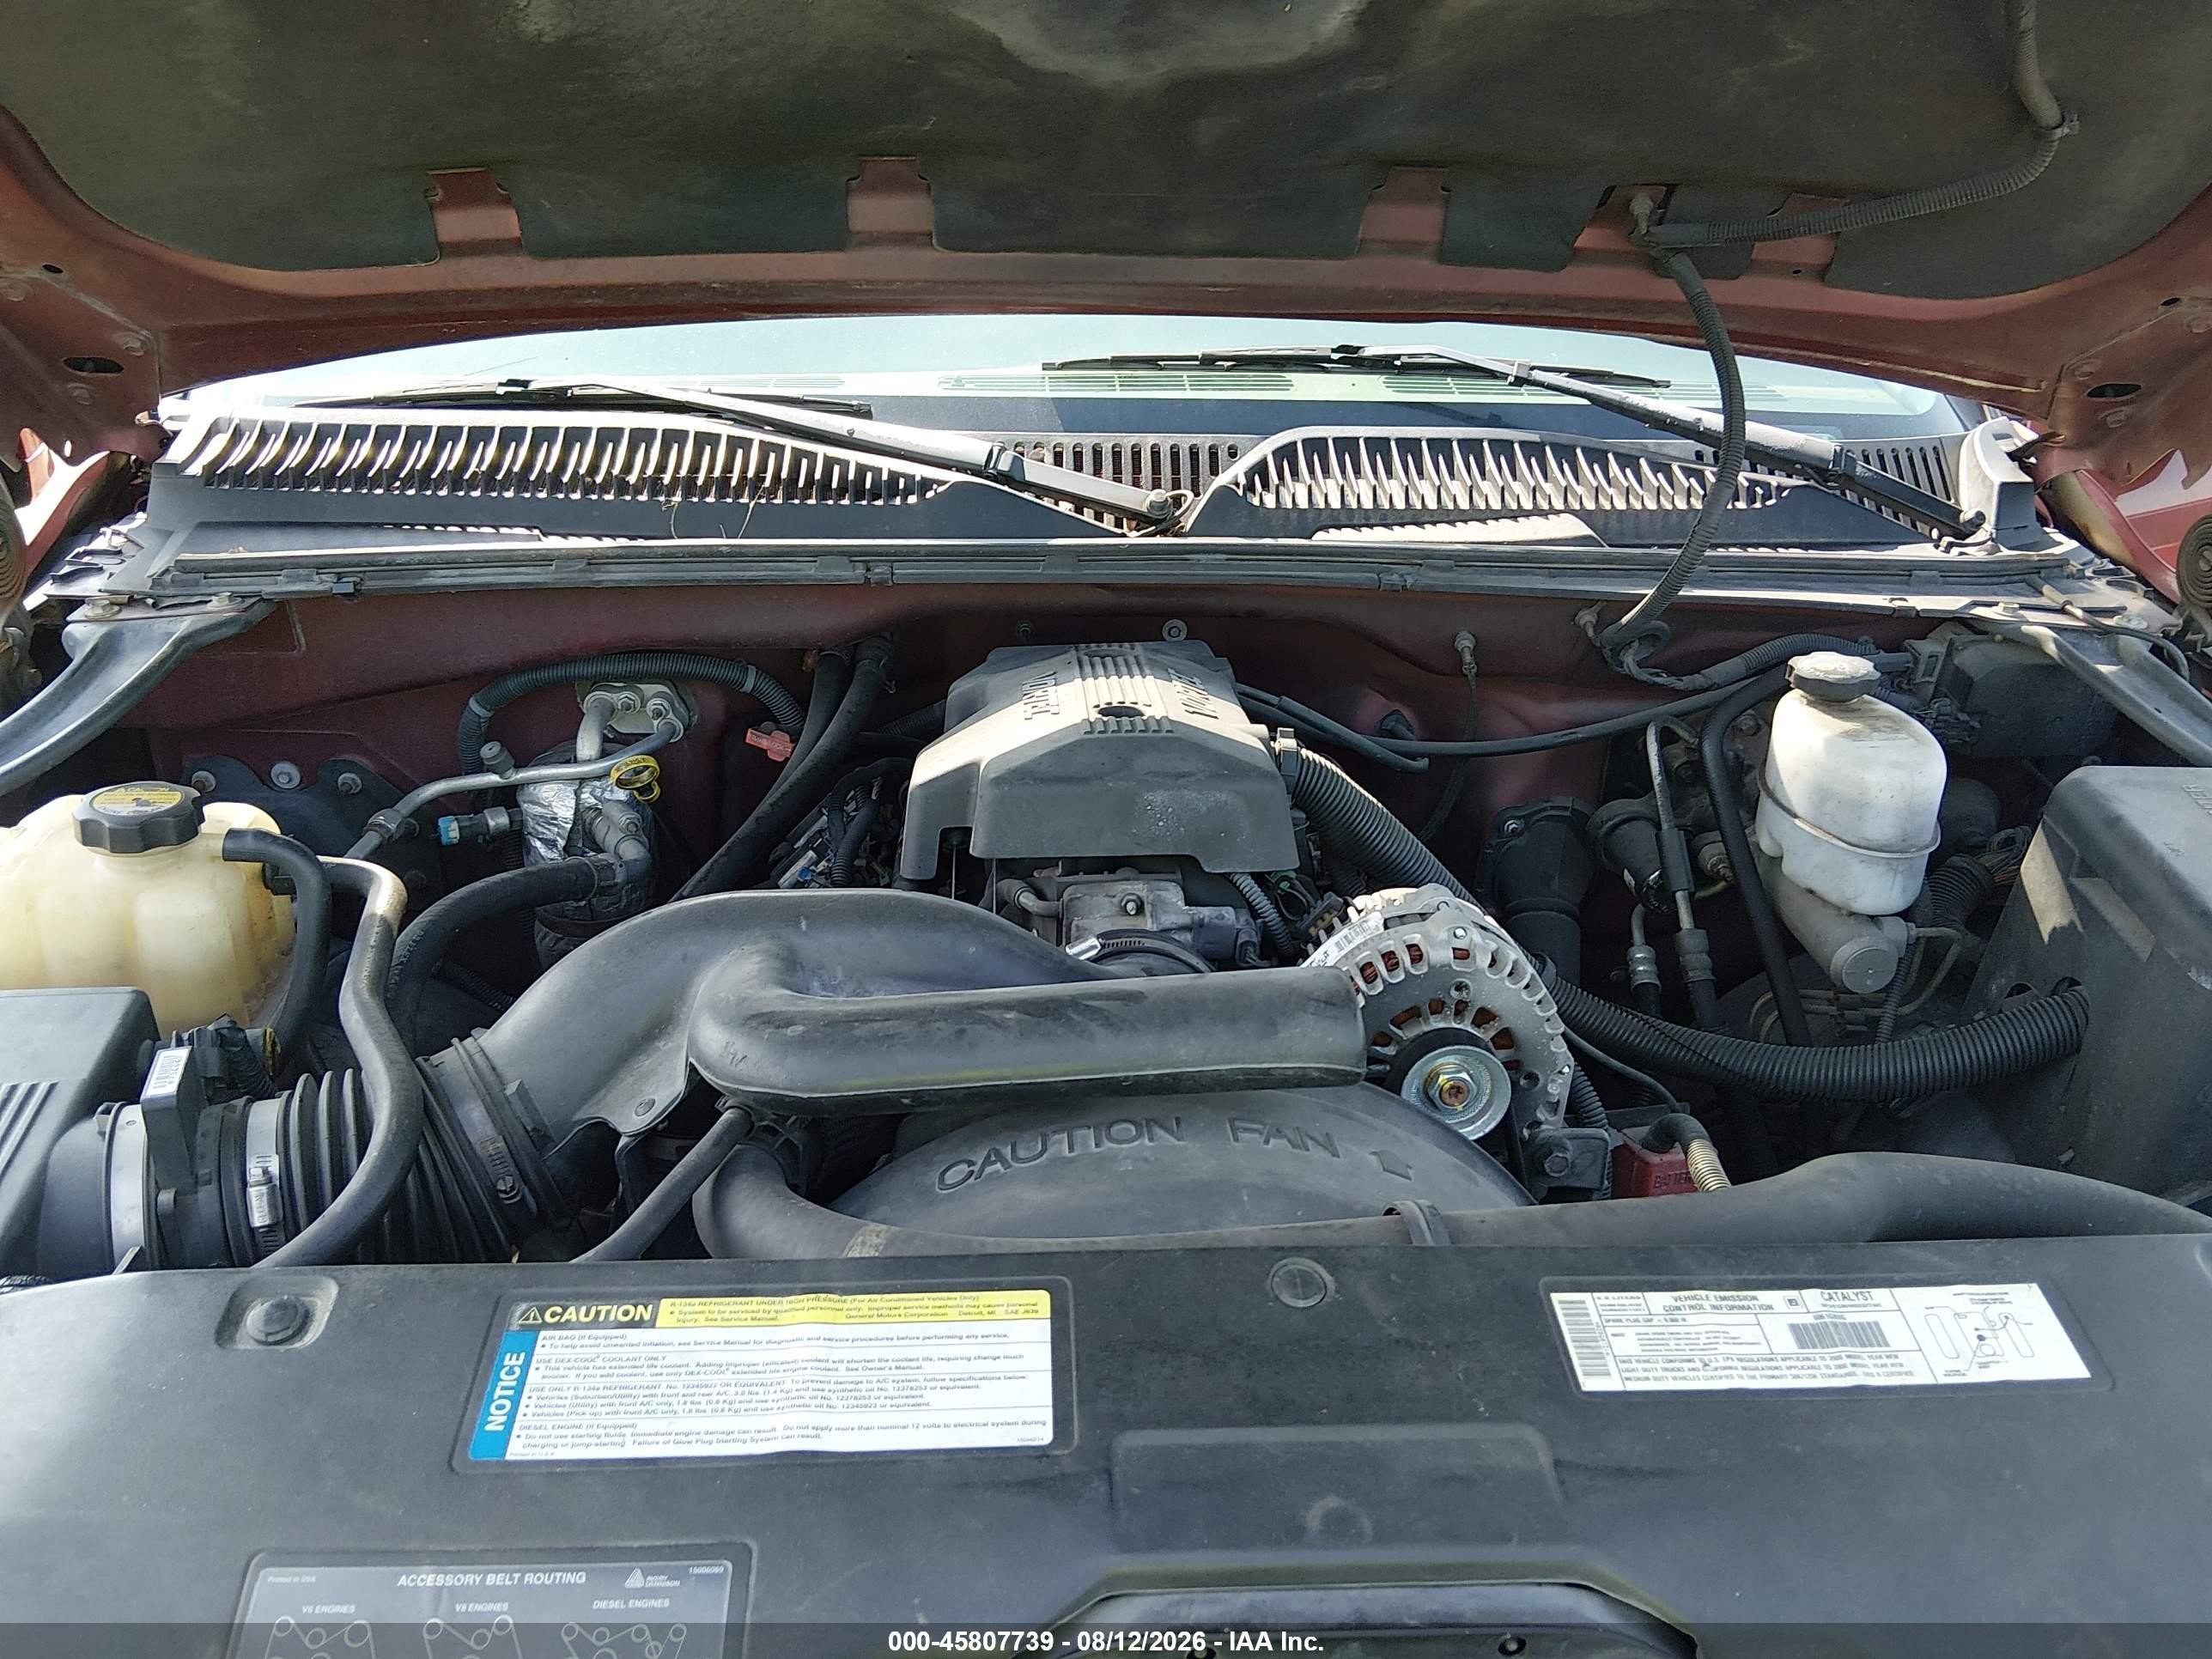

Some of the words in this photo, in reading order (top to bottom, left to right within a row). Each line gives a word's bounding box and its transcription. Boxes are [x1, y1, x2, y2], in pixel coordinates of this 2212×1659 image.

[936, 1117, 1184, 1192] CAUTION
[1226, 1119, 1340, 1159] FAN
[1654, 1171, 1693, 1189] BATTER
[1820, 1291, 1876, 1302] CATALYST
[544, 1304, 653, 1323] CAUTION
[484, 1352, 526, 1431] NOTICE
[397, 1574, 483, 1587] ACCESSORY
[486, 1573, 520, 1585] BELT
[524, 1571, 586, 1585] ROUTING
[314, 1604, 356, 1613] ENGINES
[455, 1603, 465, 1612] V8
[468, 1602, 508, 1612] ENGINES
[592, 1600, 625, 1609] DIESEL
[629, 1599, 670, 1607] ENGINES
